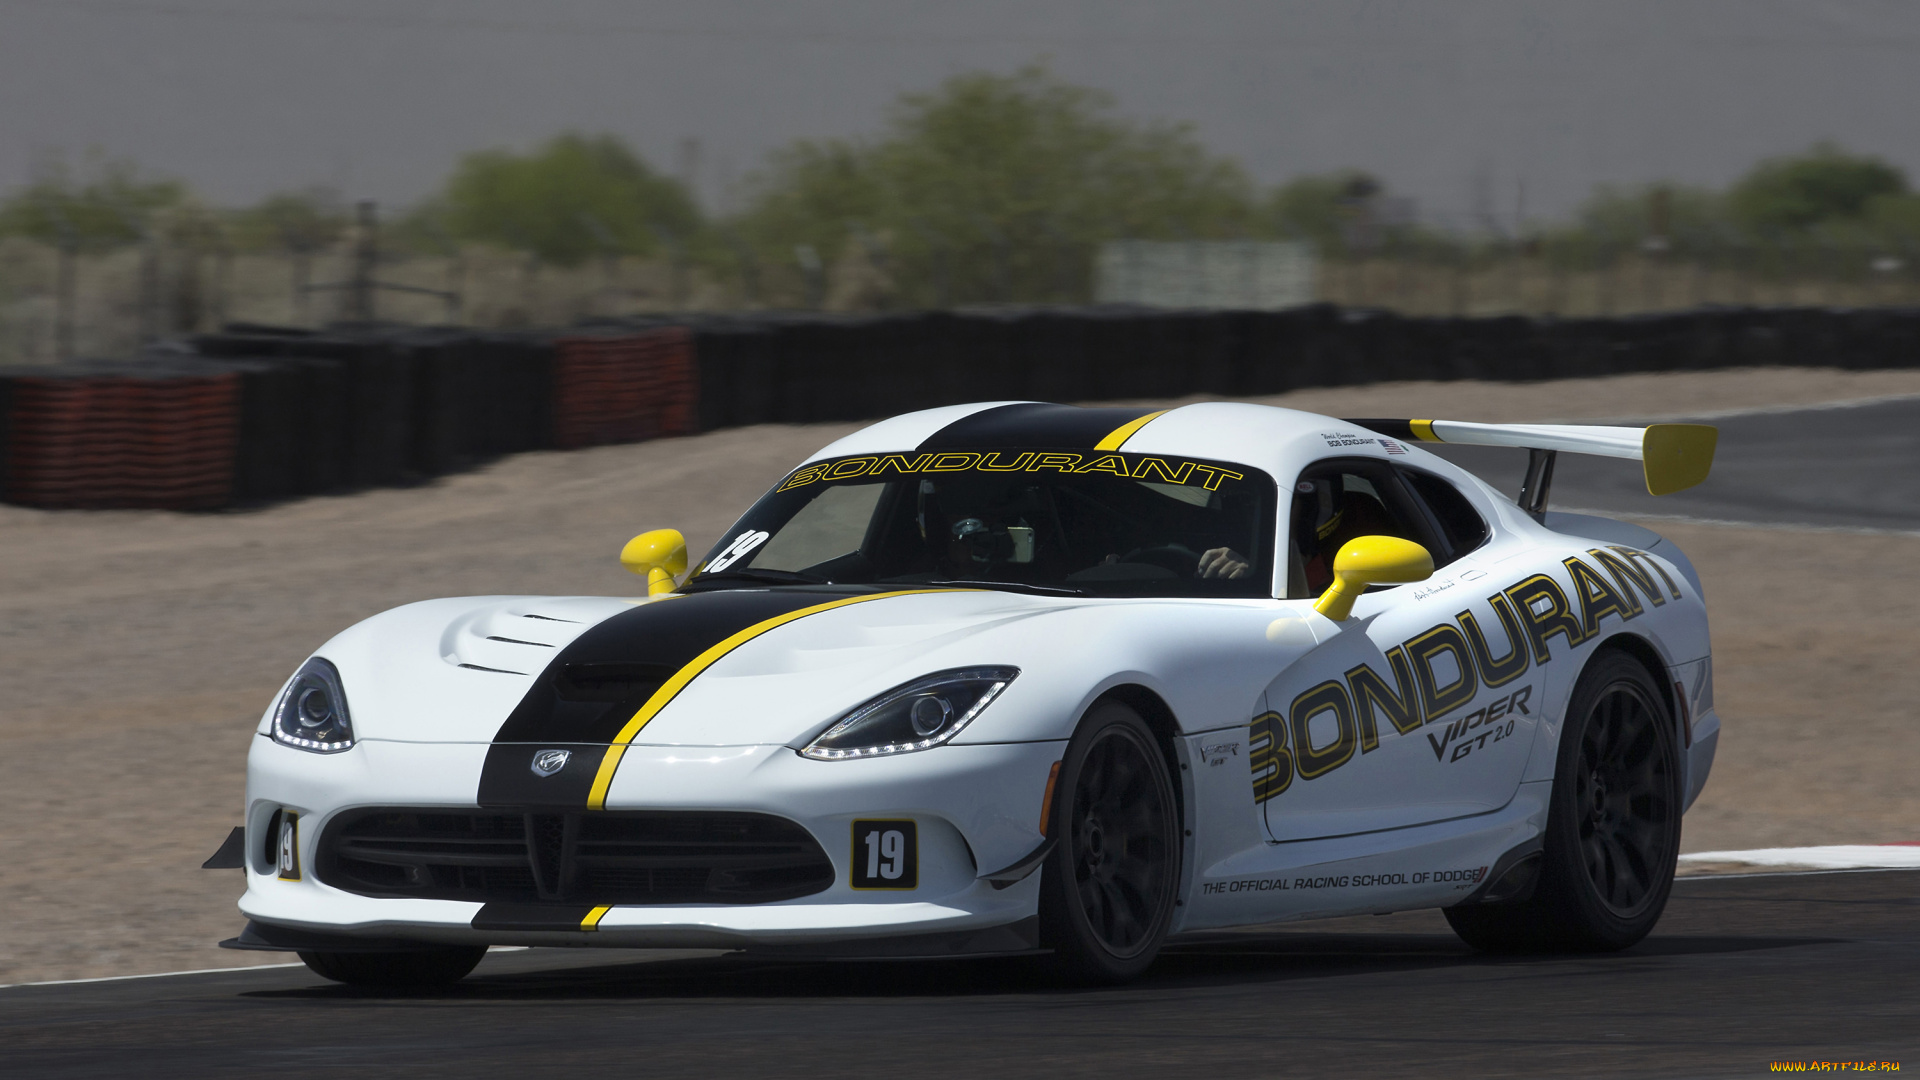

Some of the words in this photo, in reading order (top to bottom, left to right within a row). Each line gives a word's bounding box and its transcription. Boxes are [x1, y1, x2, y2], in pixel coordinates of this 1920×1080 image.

[776, 451, 1243, 492] BONDURANT
[701, 529, 769, 573] 19
[1249, 546, 1682, 805] BONDURANT
[1427, 684, 1532, 763] VIPER
[1450, 730, 1494, 763] GT
[1493, 720, 1515, 743] 2.0
[865, 830, 904, 879] 19
[1203, 882, 1226, 895] THE
[1229, 879, 1290, 893] OFFICIAL
[1293, 876, 1349, 890] RACING
[1352, 873, 1409, 887] SCHOOL
[1412, 872, 1430, 884] OF
[1433, 868, 1481, 883] DODGE
